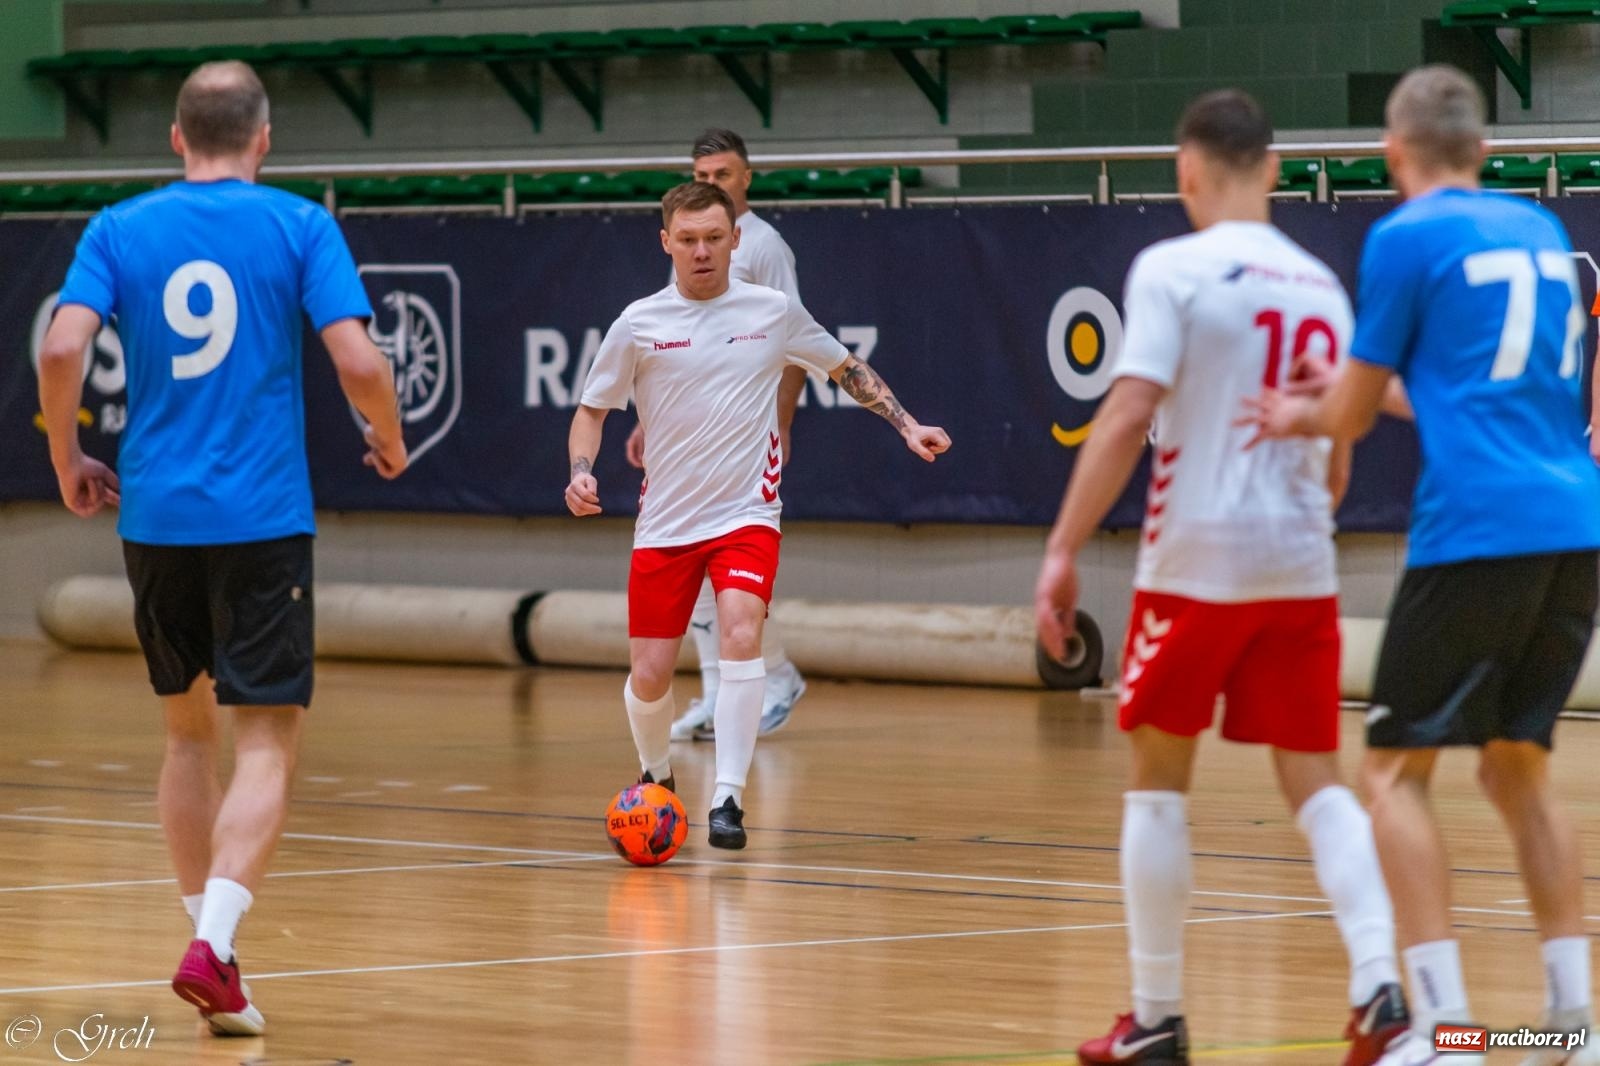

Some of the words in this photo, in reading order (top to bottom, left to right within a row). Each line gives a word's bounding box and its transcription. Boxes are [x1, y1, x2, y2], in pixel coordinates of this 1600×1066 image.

[162, 259, 238, 380] 9
[1463, 248, 1586, 382] 77
[654, 338, 691, 351] hummel
[728, 567, 764, 585] hummel
[610, 814, 649, 831] SELECT
